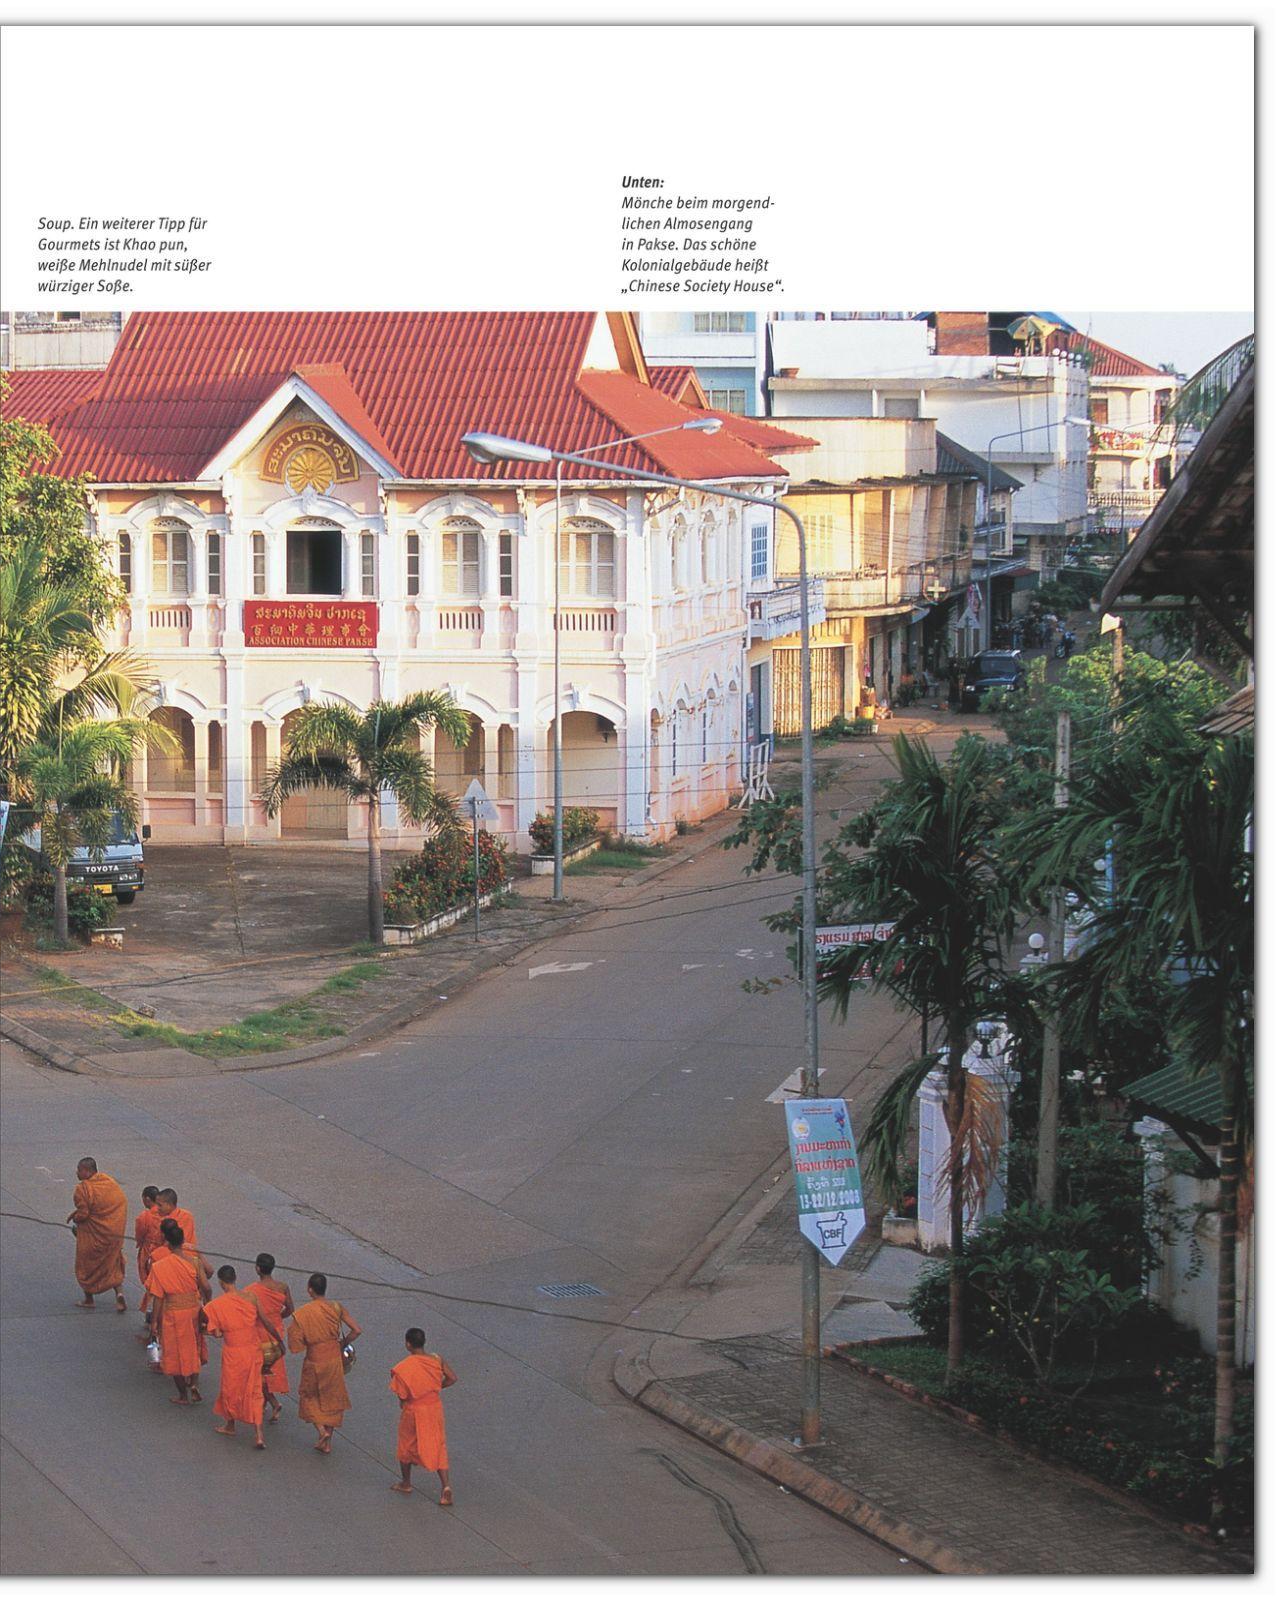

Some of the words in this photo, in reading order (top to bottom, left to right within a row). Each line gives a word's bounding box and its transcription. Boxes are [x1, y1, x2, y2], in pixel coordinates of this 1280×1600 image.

[249, 637, 305, 646] ASSOCIATION
[306, 637, 343, 646] CHINESE
[85, 865, 119, 873] TOYOTA
[823, 1228, 842, 1239] CBF
